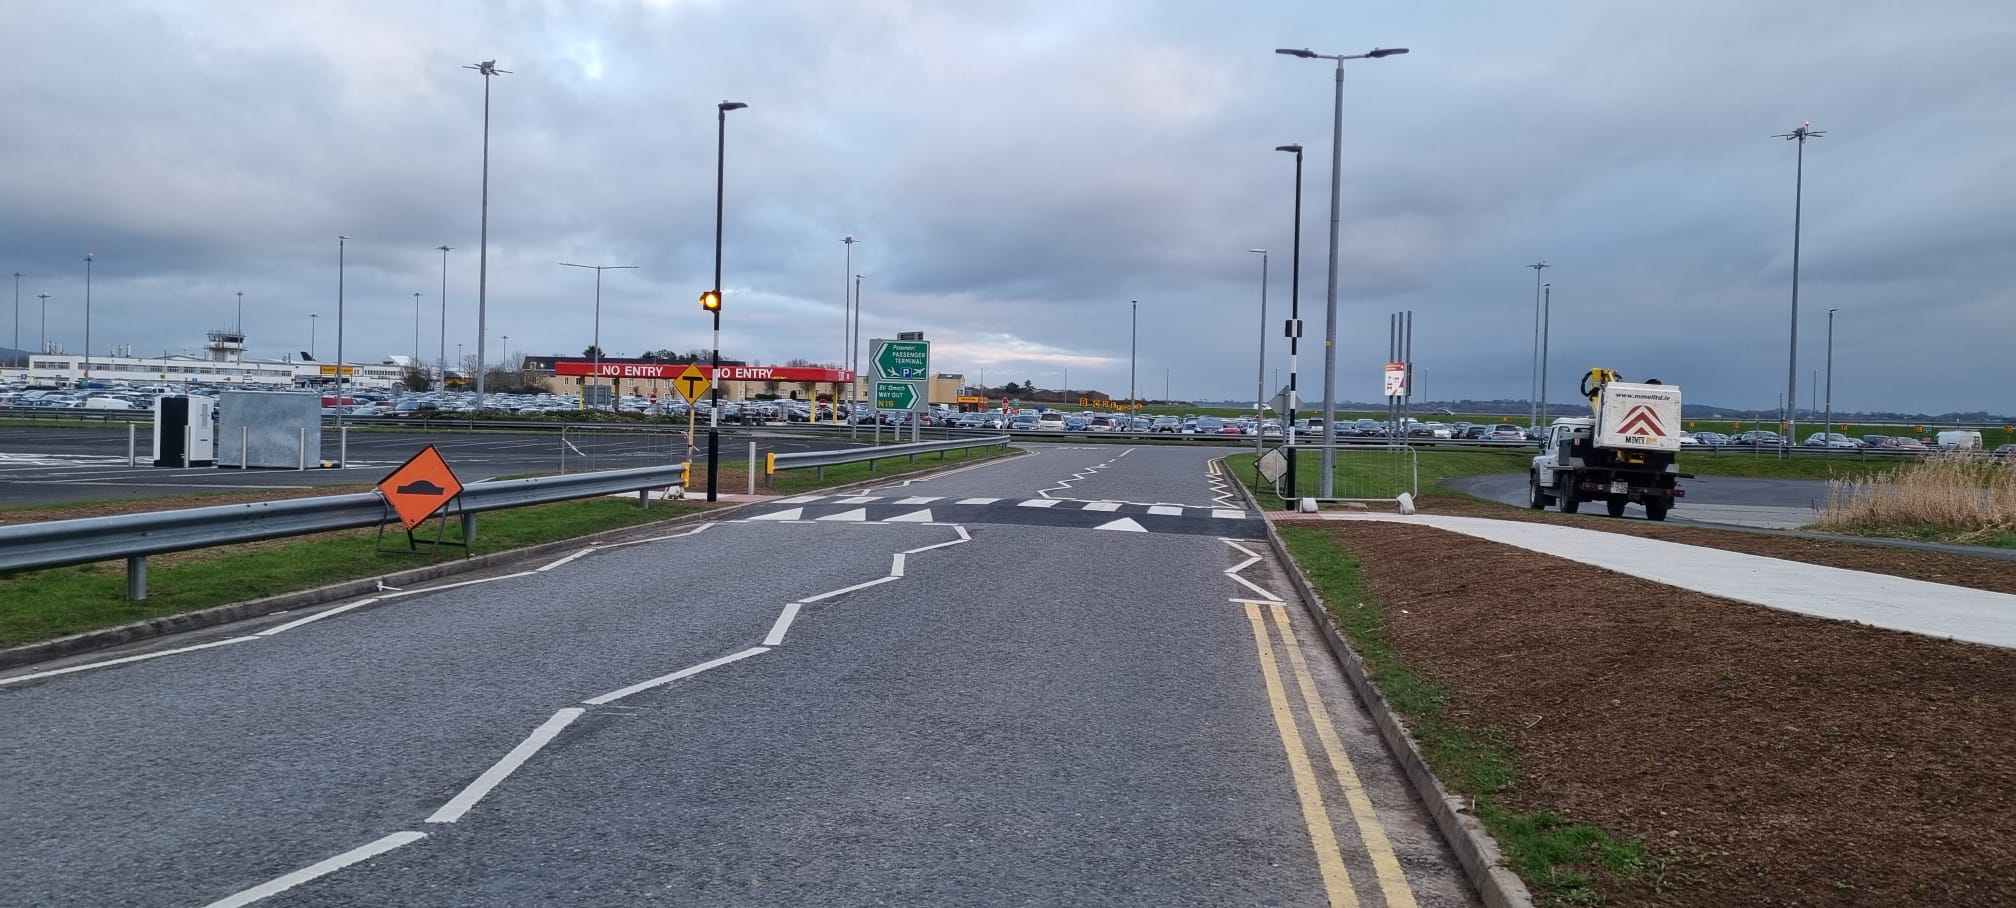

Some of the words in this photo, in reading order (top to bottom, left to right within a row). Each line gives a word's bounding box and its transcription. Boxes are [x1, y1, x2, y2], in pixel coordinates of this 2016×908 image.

[602, 366, 620, 375] NO
[625, 366, 663, 376] ENTRY
[718, 368, 730, 378] O
[736, 368, 773, 378] ENTRY
